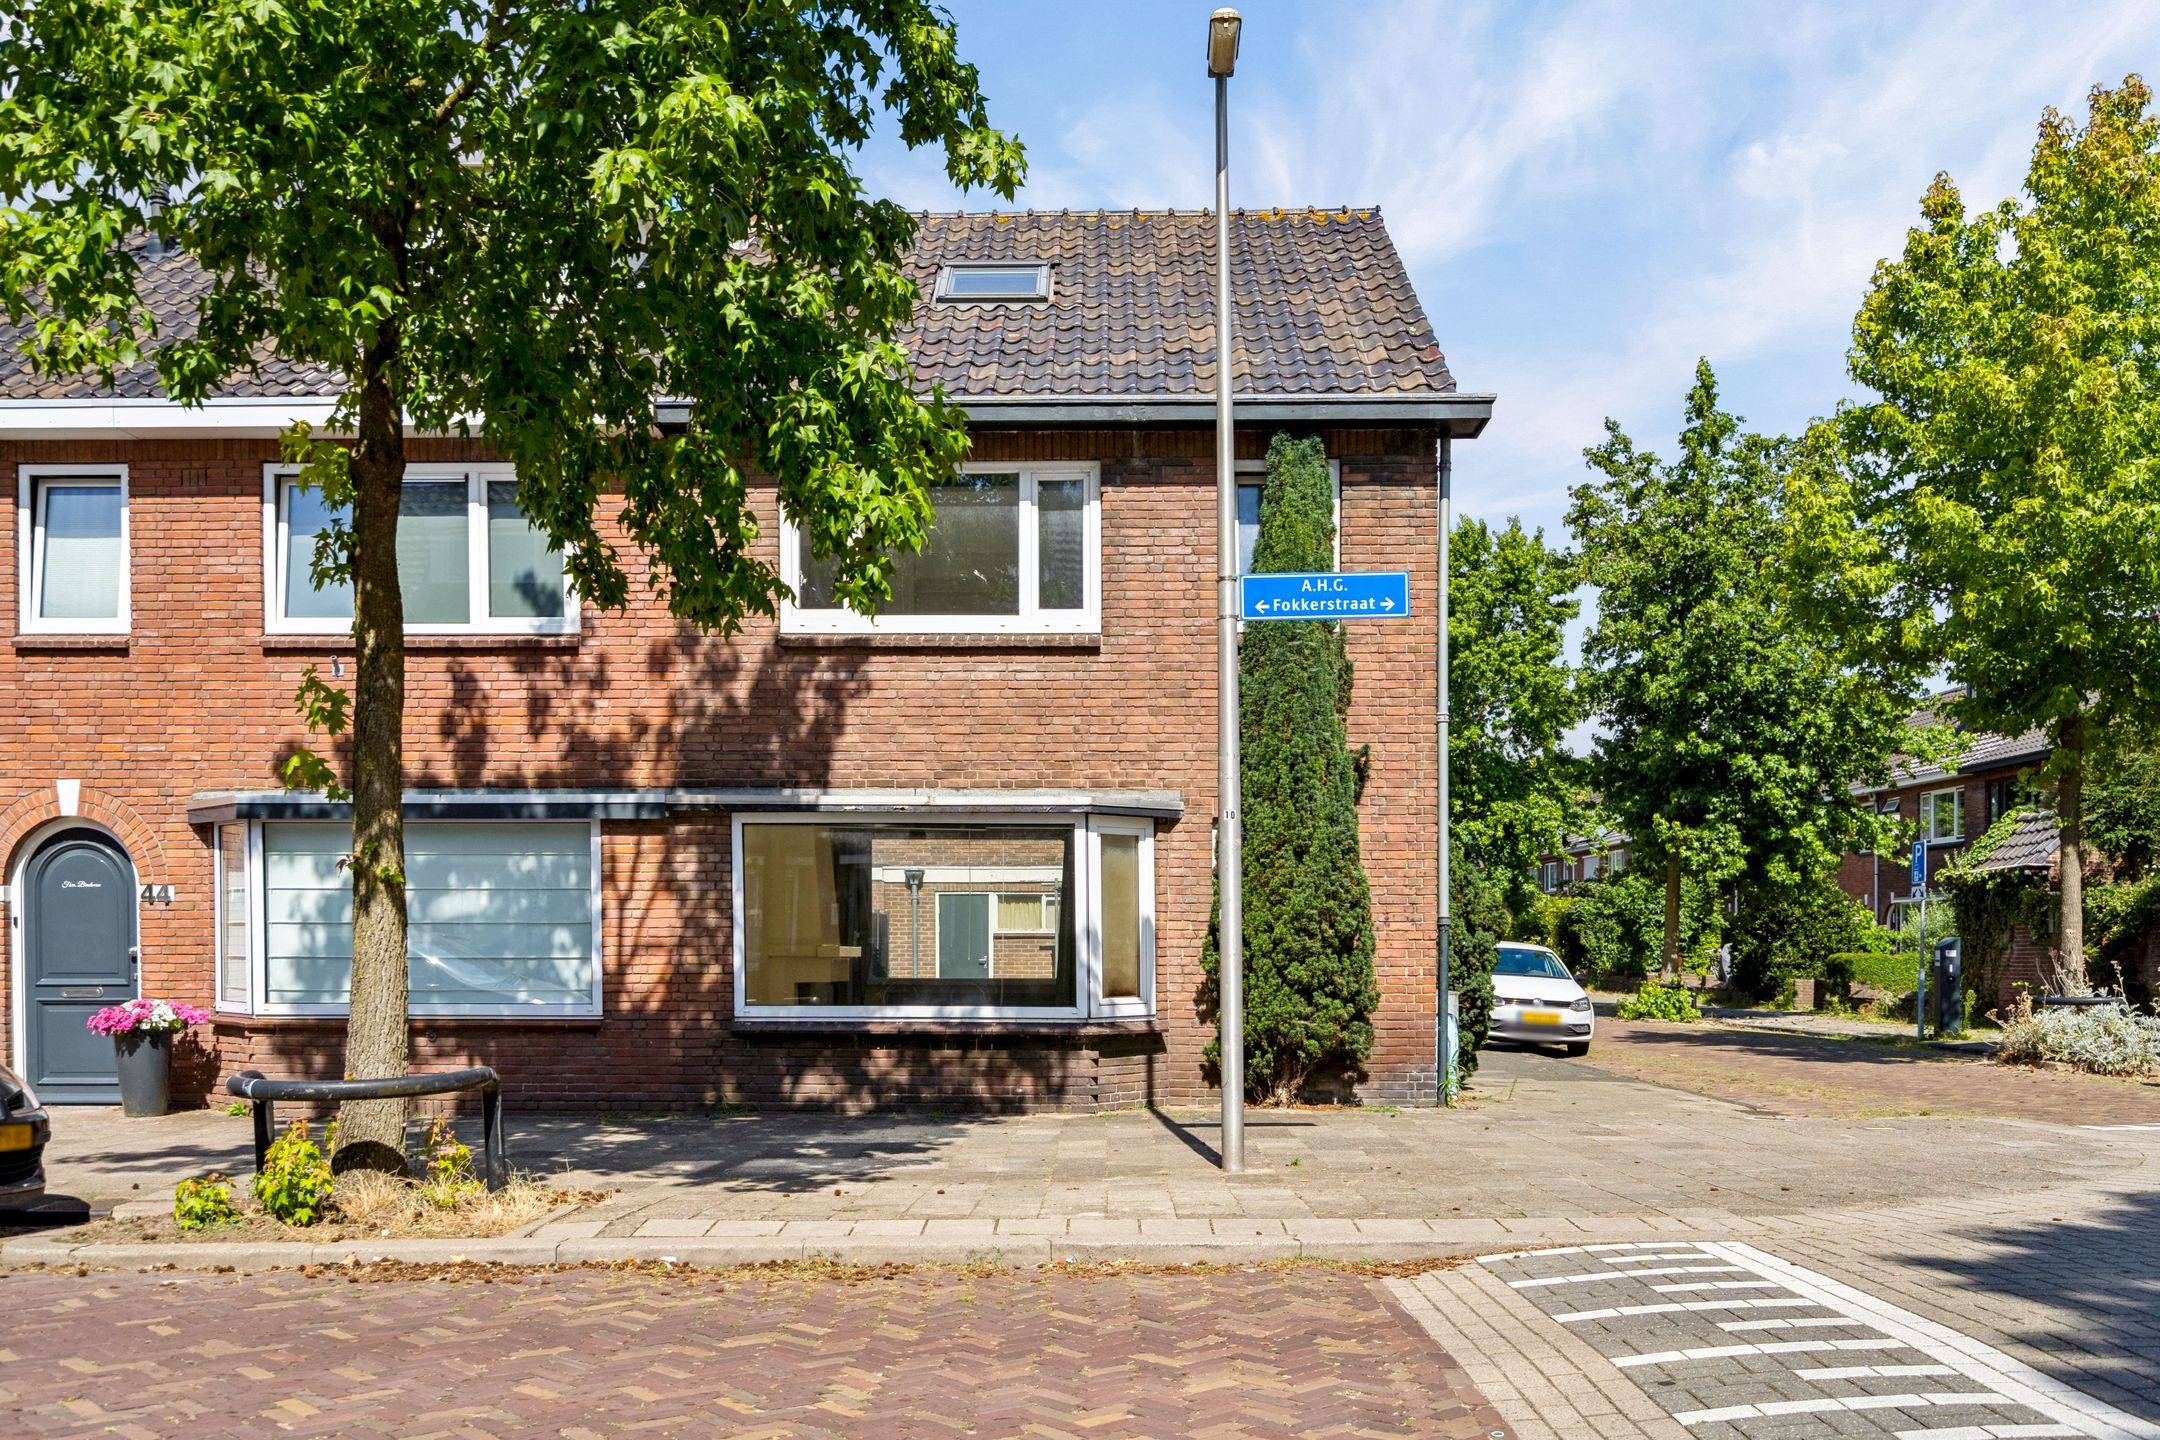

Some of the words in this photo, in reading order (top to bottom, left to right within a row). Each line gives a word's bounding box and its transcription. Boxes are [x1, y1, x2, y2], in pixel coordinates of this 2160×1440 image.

[1301, 578, 1348, 592] A.H.G.
[1273, 597, 1376, 612] Fokkerstraat
[1225, 810, 1236, 820] 10
[1915, 844, 1923, 864] P
[140, 884, 171, 904] 44
